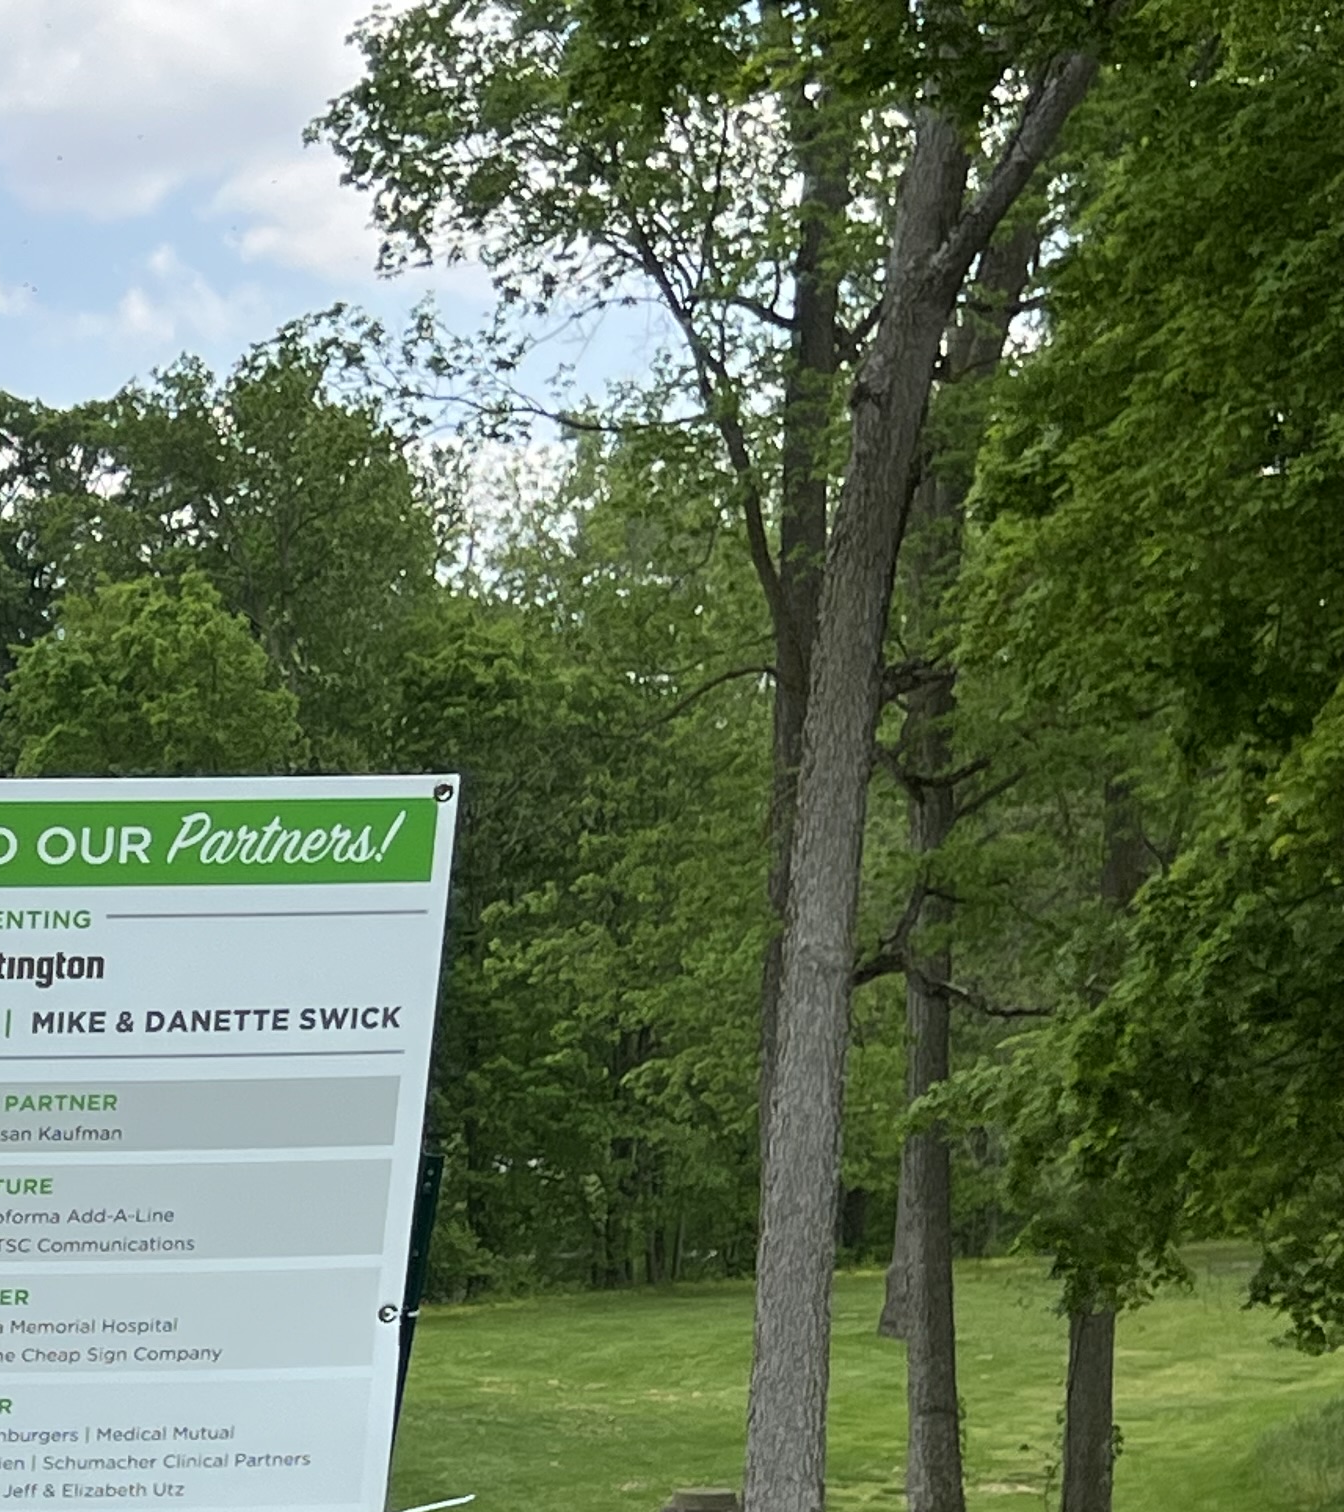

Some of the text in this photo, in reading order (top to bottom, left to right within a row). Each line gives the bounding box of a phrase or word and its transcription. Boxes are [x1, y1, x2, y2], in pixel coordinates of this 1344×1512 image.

[36, 825, 152, 865] OUR
[166, 809, 406, 865] Partners!
[31, 1010, 107, 1034] MIKE
[114, 1010, 134, 1034] &
[144, 1007, 290, 1033] DANETTE
[298, 1005, 402, 1031] SWICK
[4, 1093, 118, 1112] PARTNER
[38, 1124, 122, 1142] Kaufman
[66, 1207, 175, 1224] Add-A-Line
[36, 1236, 195, 1254] Communications
[9, 1318, 96, 1335] Memorial
[101, 1317, 178, 1336] Hospital
[20, 1347, 81, 1365] Cheap
[86, 1346, 128, 1364] Sign
[132, 1345, 223, 1363] Company
[96, 1425, 167, 1442] Medical
[172, 1424, 236, 1441] Mutual
[42, 1454, 158, 1471] Schumacher
[162, 1452, 229, 1469] Clinical
[234, 1452, 311, 1468] Partners
[2, 1482, 38, 1499] Jeff
[42, 1482, 56, 1499] &
[61, 1482, 148, 1499] Elizabeth
[152, 1482, 185, 1497] Utz
